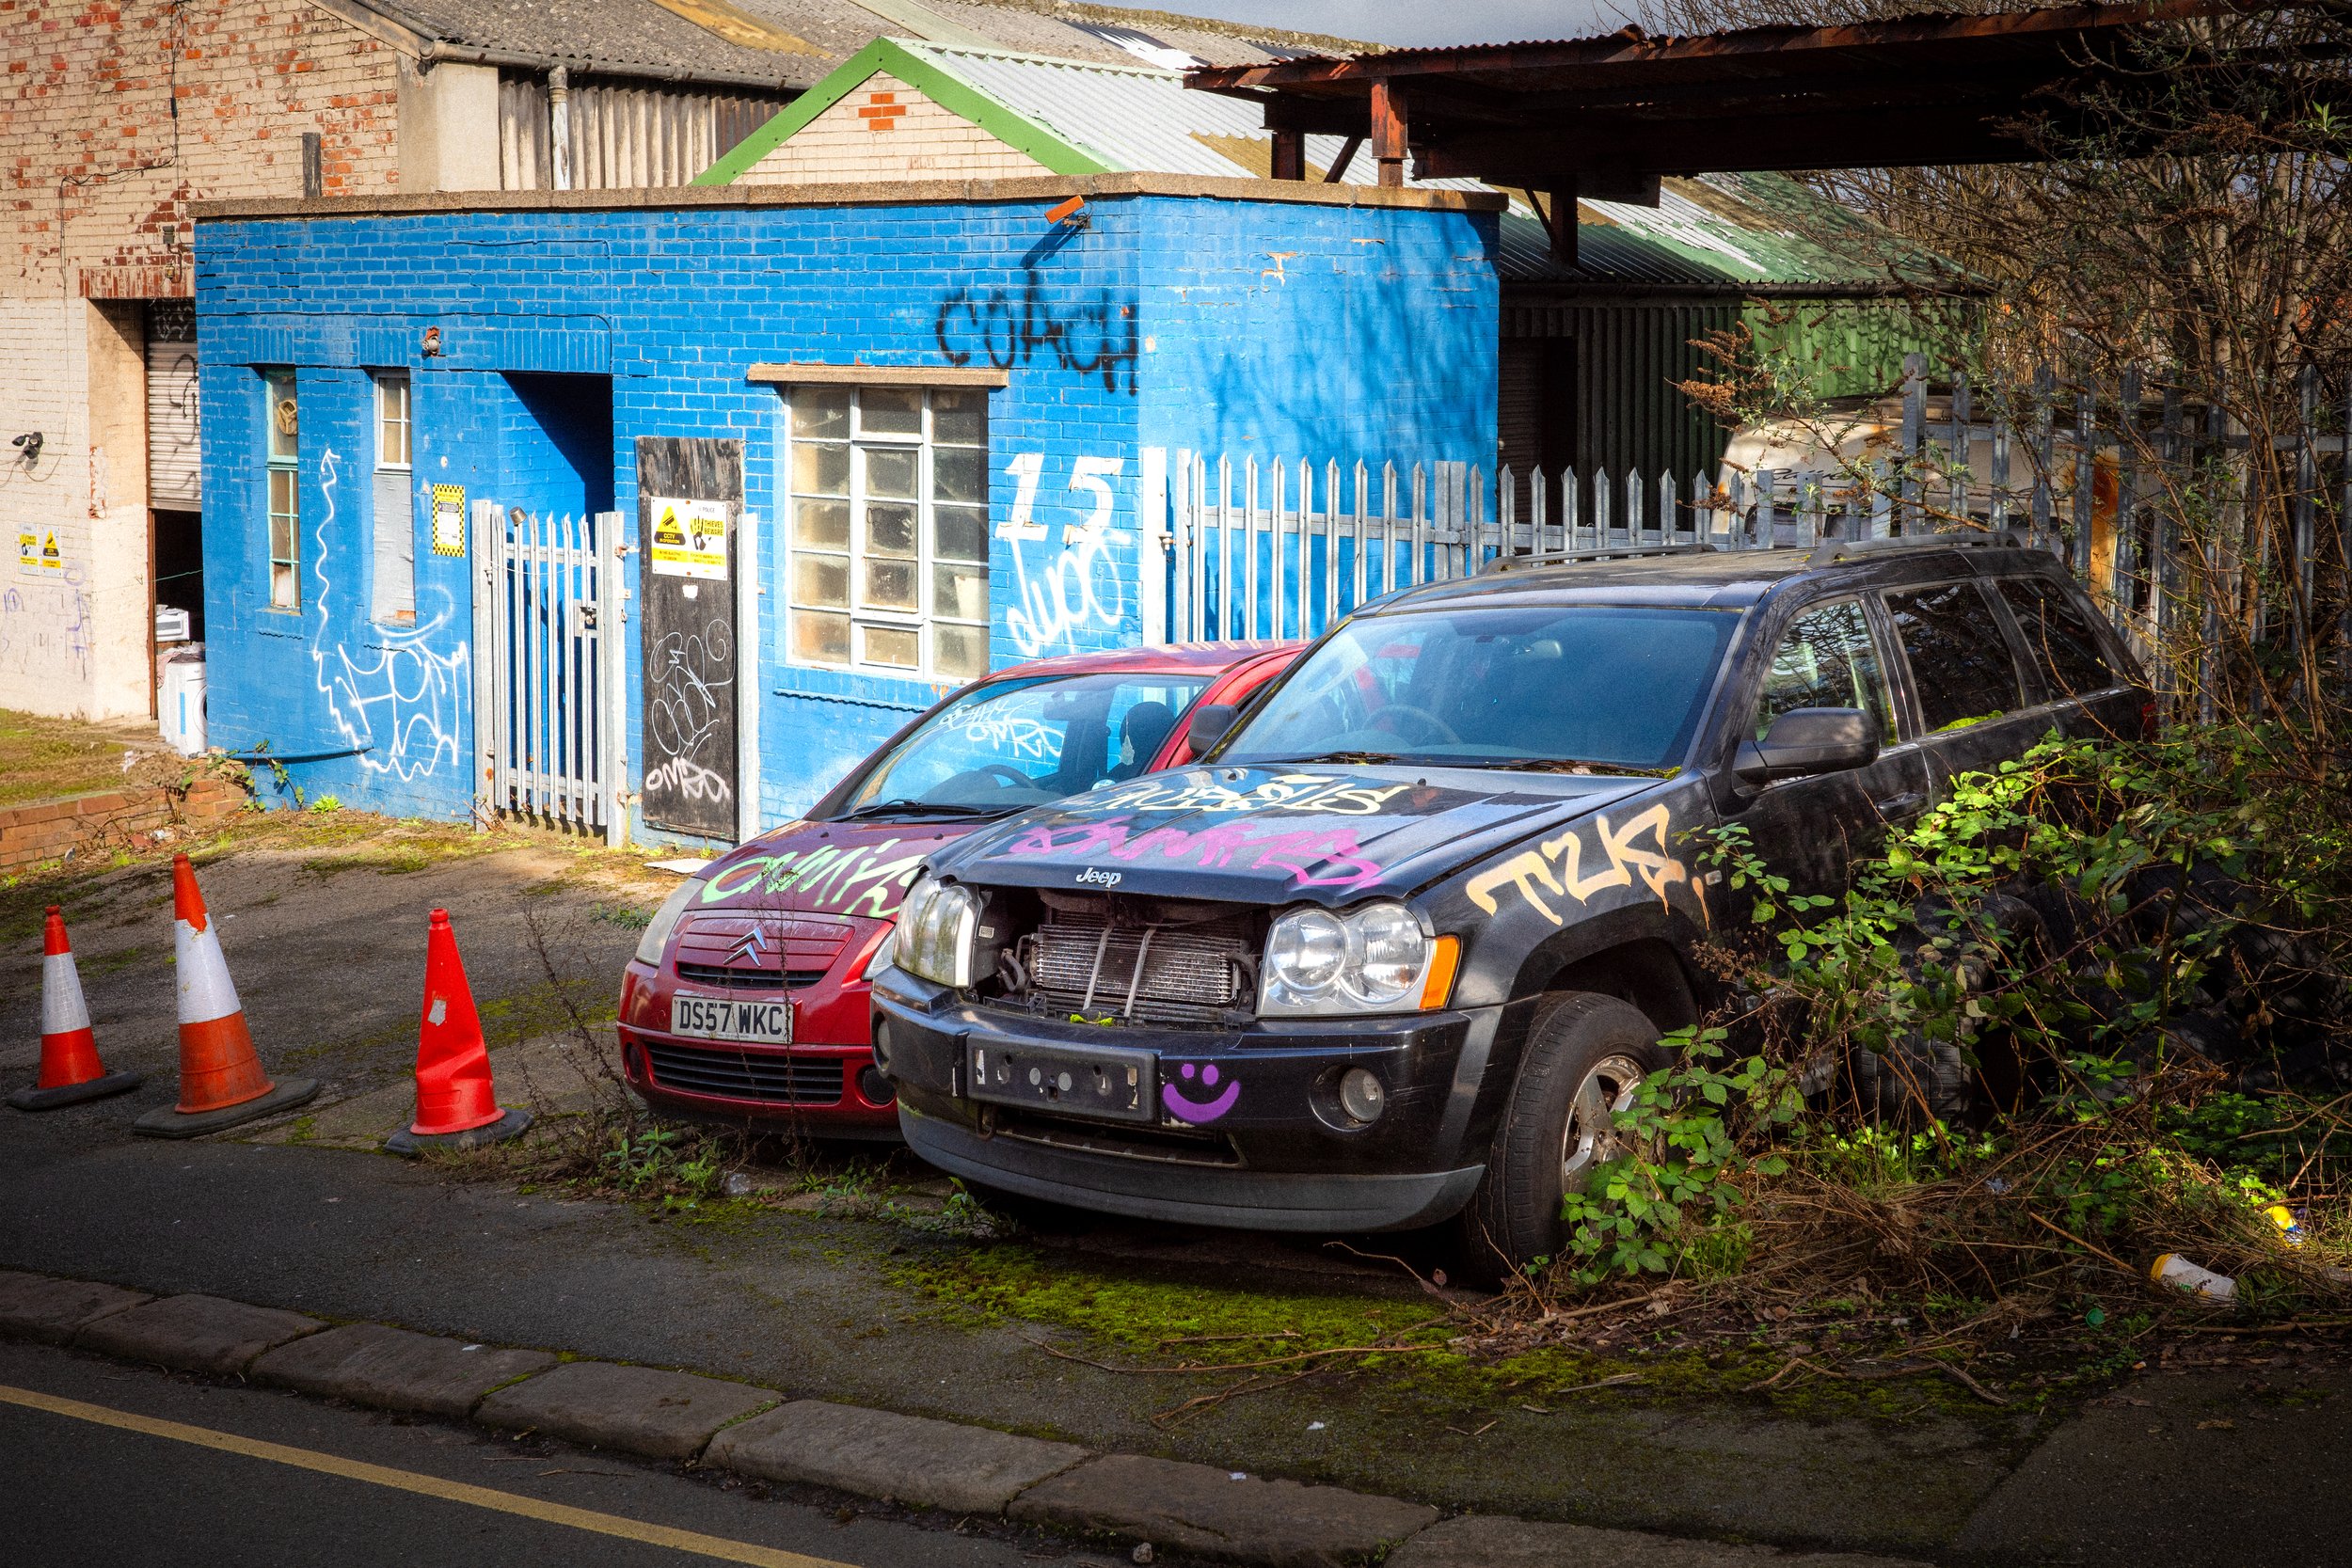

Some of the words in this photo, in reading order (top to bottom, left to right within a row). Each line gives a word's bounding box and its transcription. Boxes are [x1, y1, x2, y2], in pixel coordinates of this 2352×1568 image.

[995, 452, 1127, 546] 15
[704, 519, 723, 528] THIEVES
[704, 528, 723, 536] BEWARE
[1075, 866, 1122, 889] Jeep
[679, 1000, 732, 1032] DS57
[739, 1005, 783, 1036] WKC
